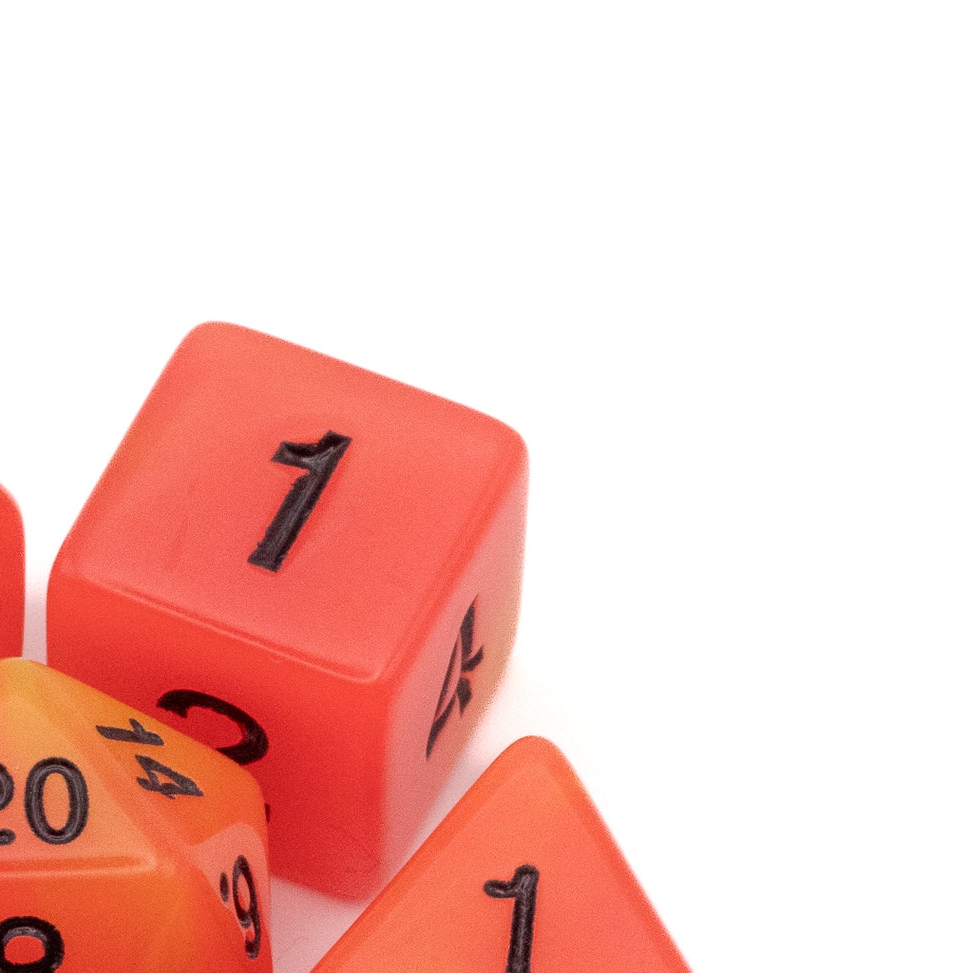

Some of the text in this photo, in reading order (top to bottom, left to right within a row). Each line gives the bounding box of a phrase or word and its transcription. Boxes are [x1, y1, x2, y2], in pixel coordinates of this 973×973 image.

[248, 429, 353, 573] 1
[426, 595, 484, 759] 4
[96, 717, 204, 800] 14
